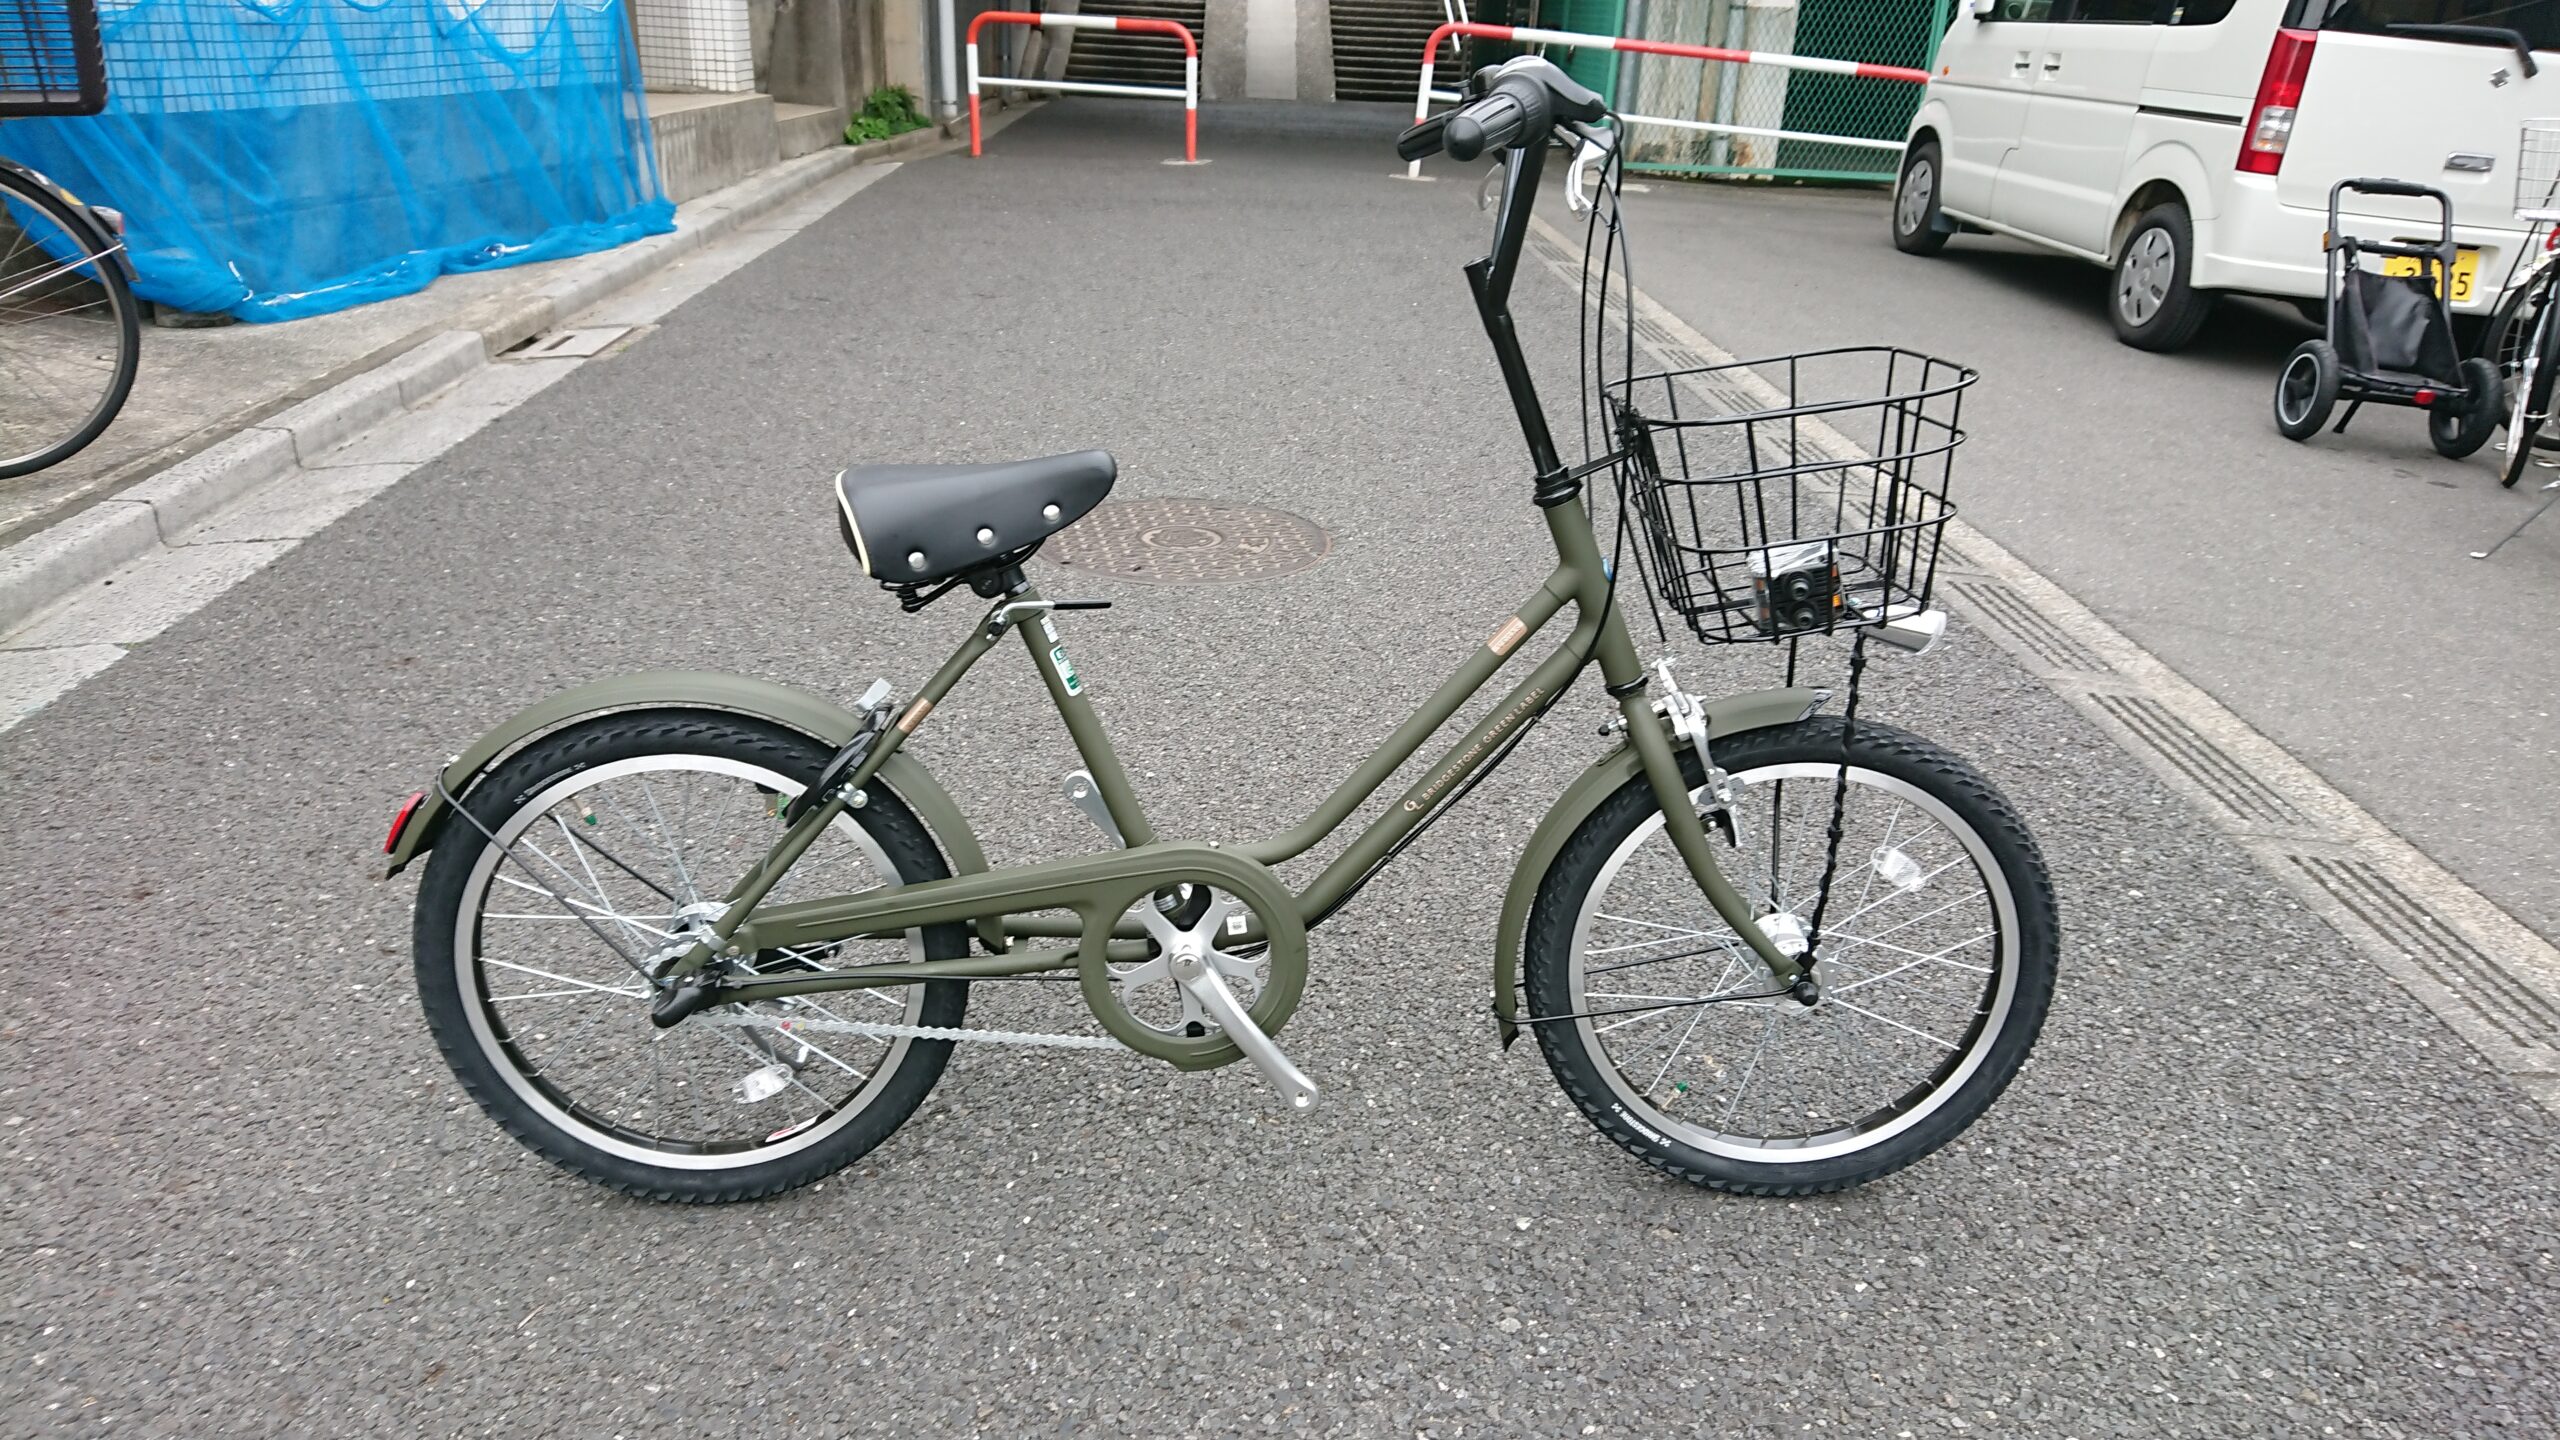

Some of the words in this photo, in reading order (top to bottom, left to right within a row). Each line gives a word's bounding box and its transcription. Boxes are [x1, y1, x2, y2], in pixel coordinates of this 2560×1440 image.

[1421, 743, 1483, 801] BRIDGESTONE
[1482, 713, 1516, 744] GREEN
[1513, 687, 1545, 715] LABEL
